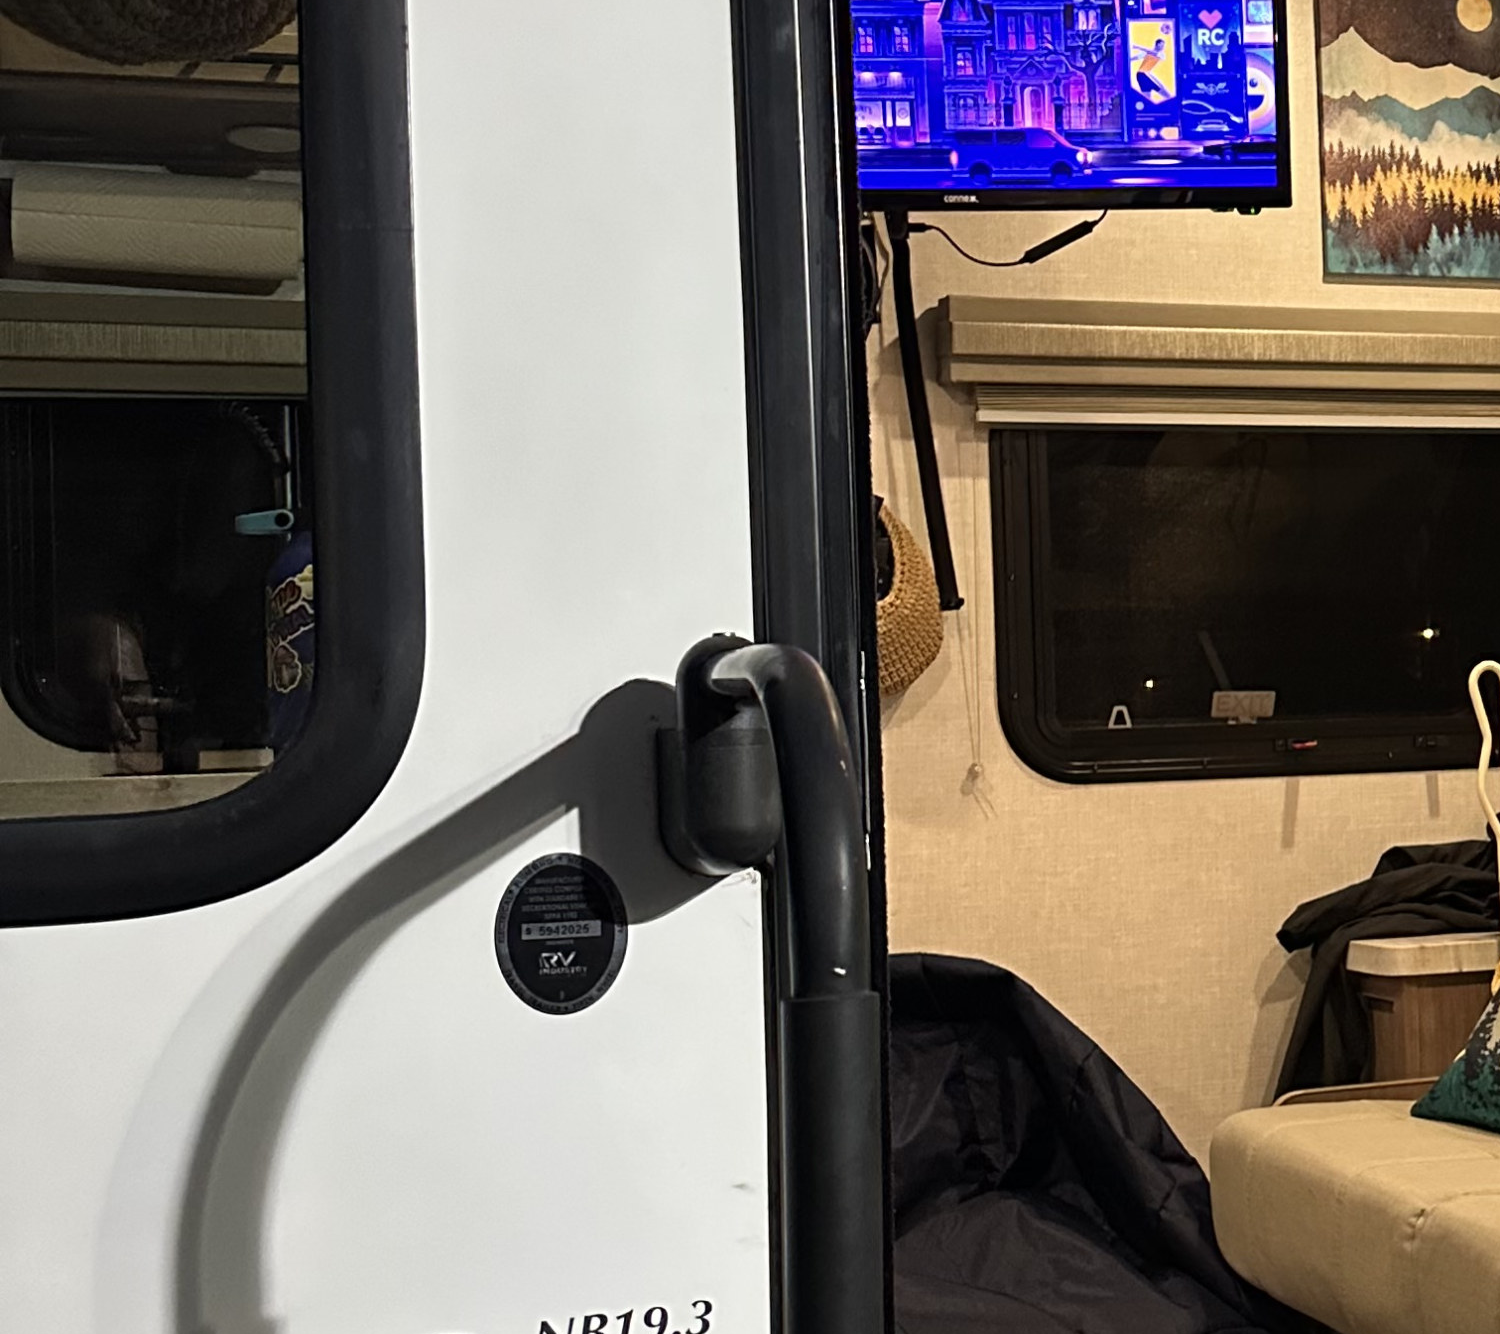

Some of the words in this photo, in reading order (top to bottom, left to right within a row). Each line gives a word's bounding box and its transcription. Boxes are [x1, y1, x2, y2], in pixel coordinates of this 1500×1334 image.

[1197, 28, 1225, 46] RC
[1215, 693, 1271, 716] EXIT
[539, 951, 576, 968] RV
